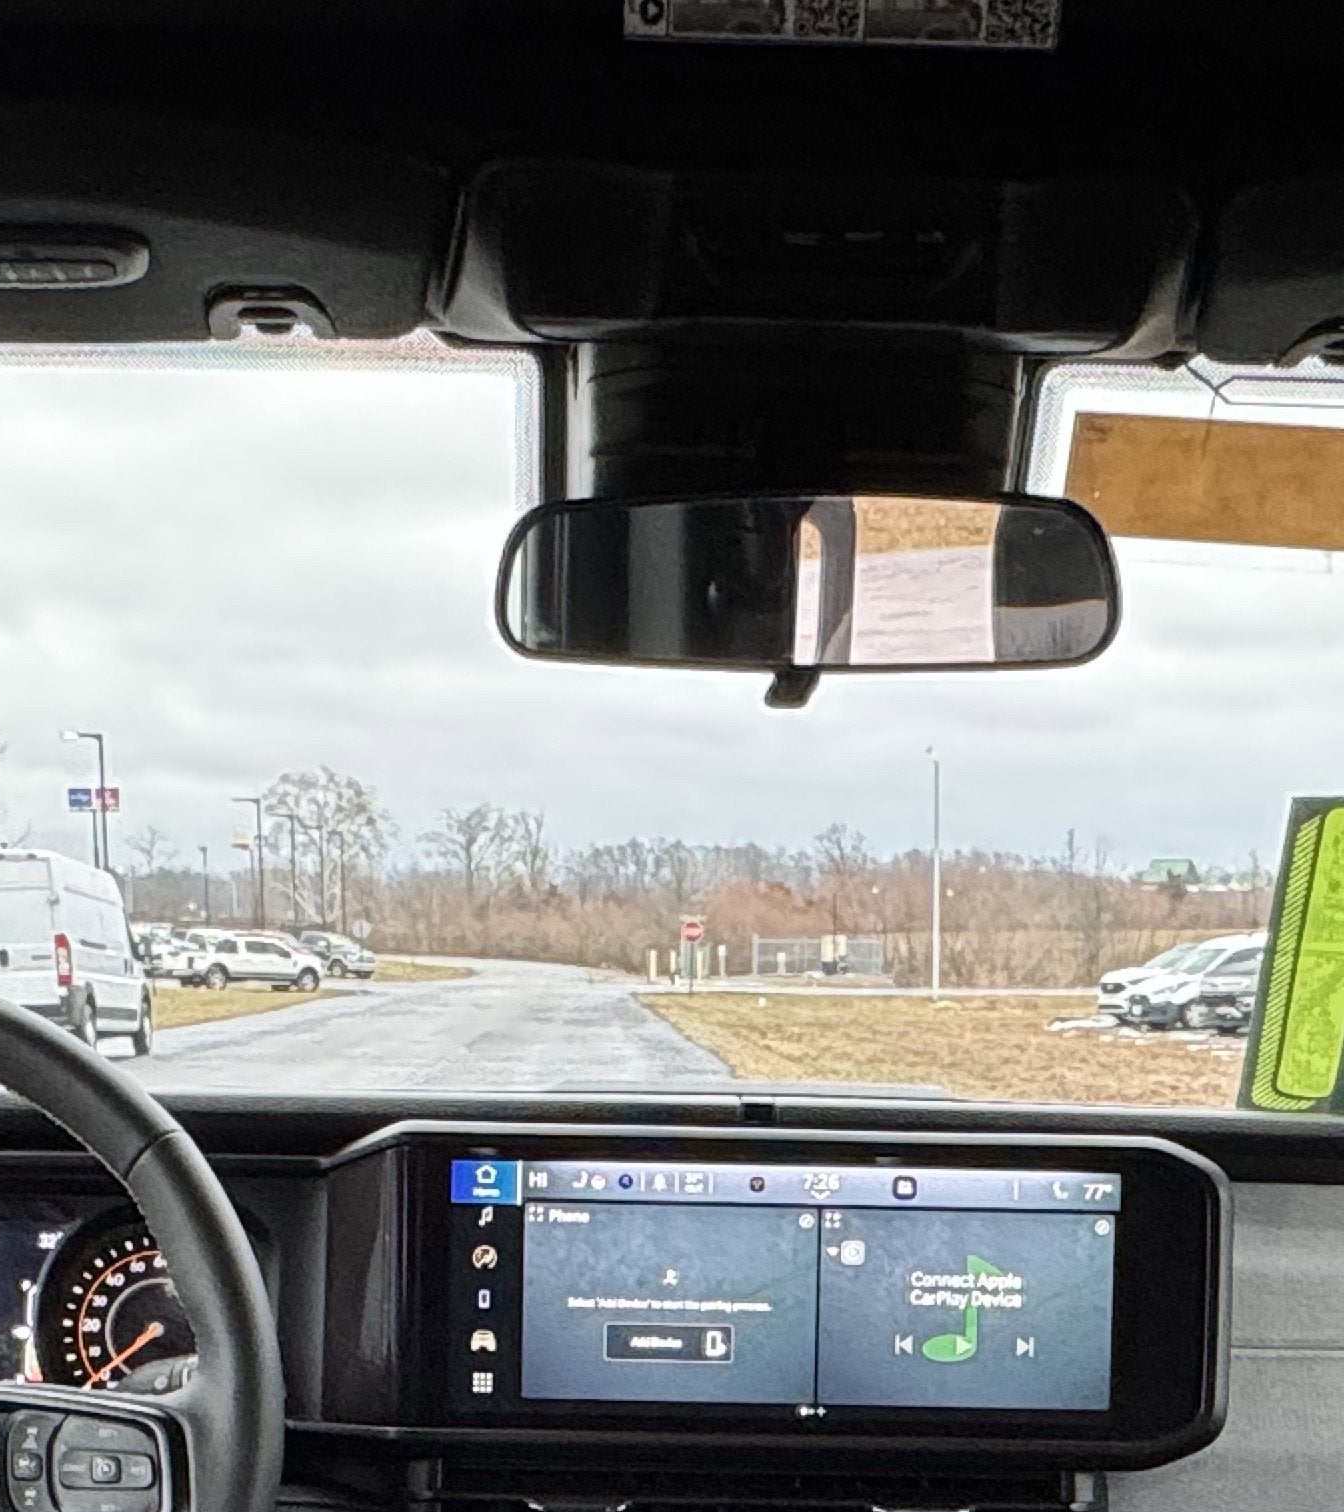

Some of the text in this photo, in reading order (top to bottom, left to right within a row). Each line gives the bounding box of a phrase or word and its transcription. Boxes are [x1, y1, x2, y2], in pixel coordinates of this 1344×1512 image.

[802, 1174, 840, 1191] 7:26
[548, 1208, 591, 1224] Phone
[910, 1271, 1022, 1291] Connect Apple
[910, 1288, 1022, 1309] CarPlay Device
